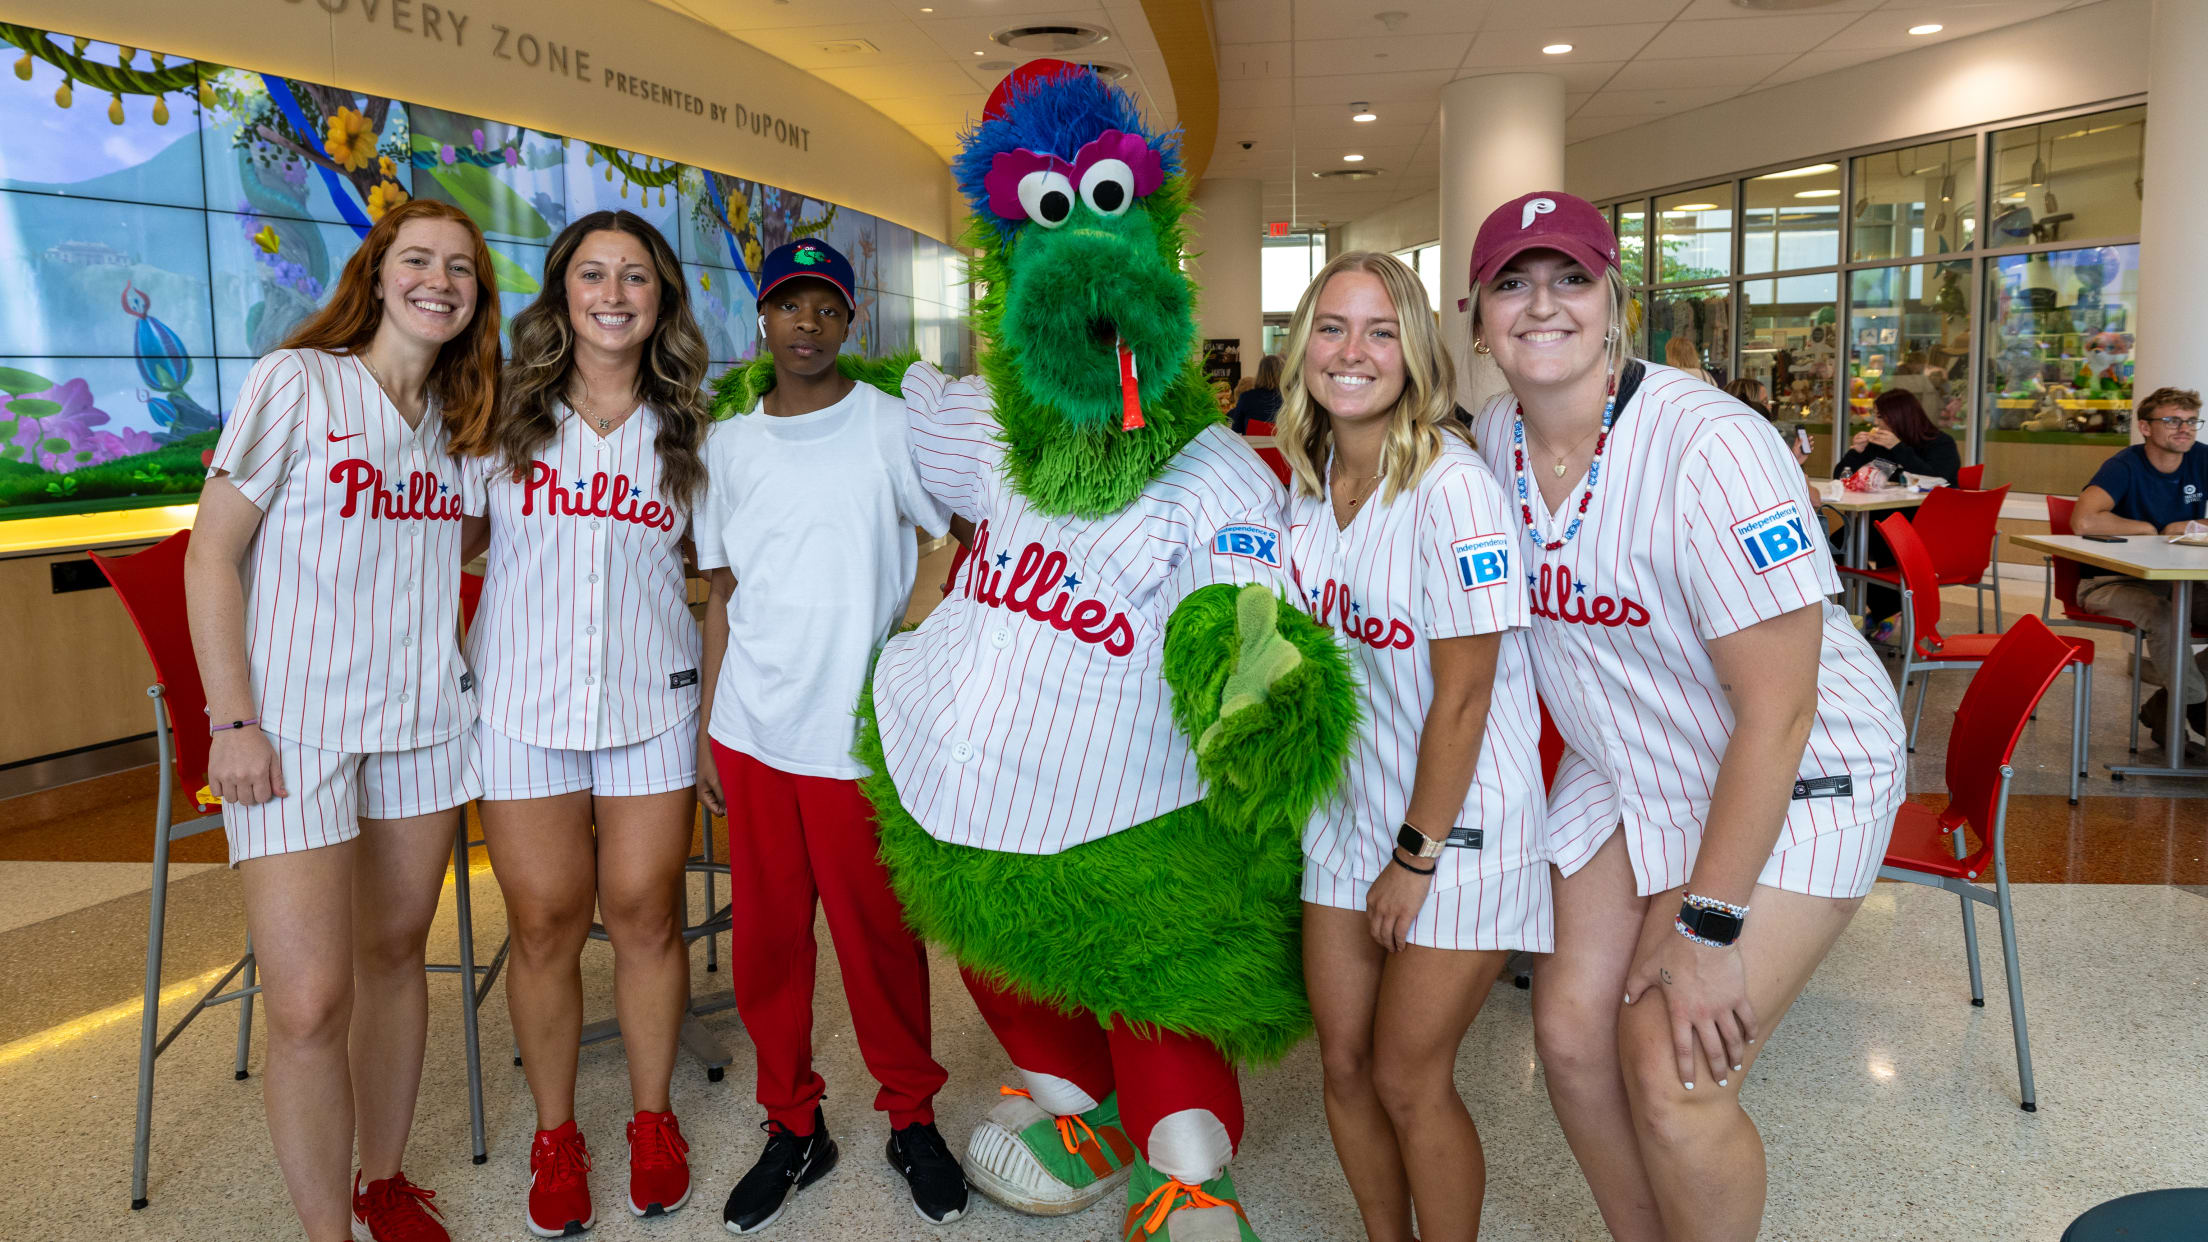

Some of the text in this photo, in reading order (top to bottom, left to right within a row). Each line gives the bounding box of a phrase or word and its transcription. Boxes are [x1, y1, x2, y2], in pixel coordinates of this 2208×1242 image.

[491, 24, 592, 83] ZONE
[604, 68, 704, 117] PRESENTED
[710, 102, 728, 124] BY
[1270, 222, 1288, 236] EXIT
[1521, 198, 1556, 230] P
[329, 458, 463, 522] Phillie
[511, 460, 675, 533] Phillies
[1217, 533, 1276, 563] IBX
[1744, 517, 1813, 569] IBX
[1530, 563, 1650, 627] illies
